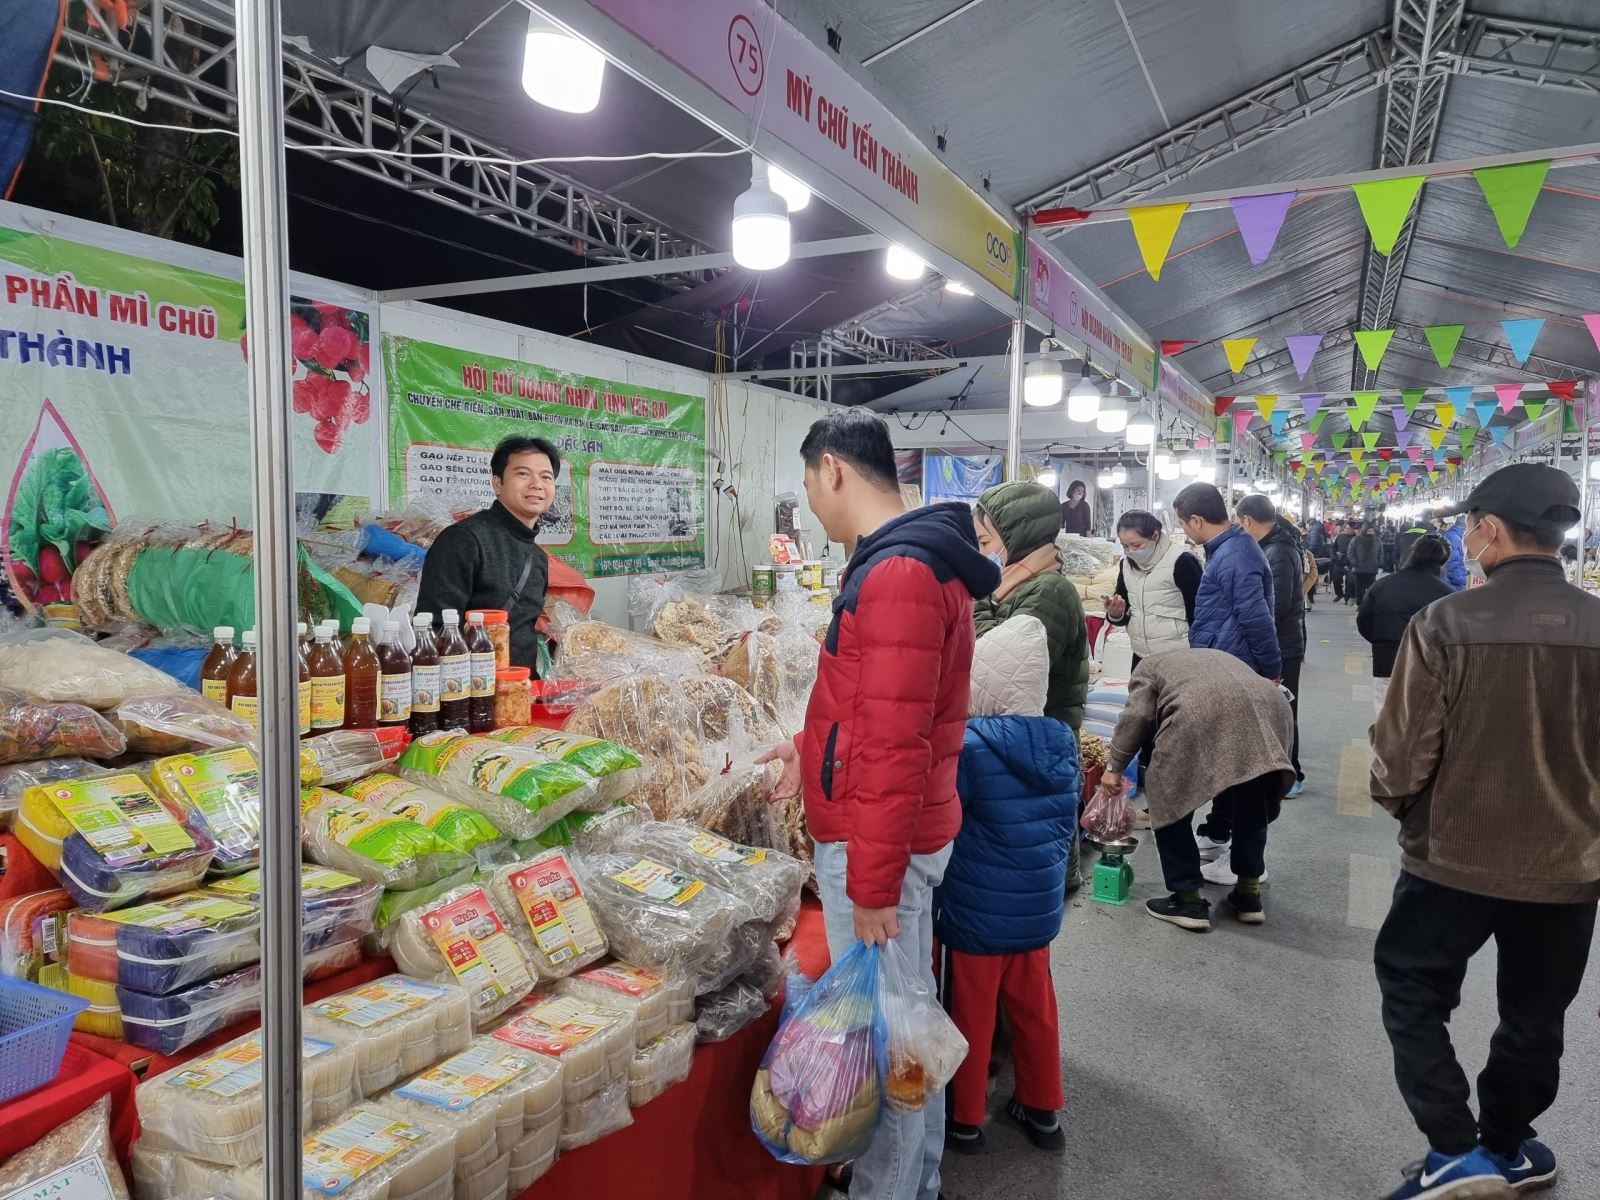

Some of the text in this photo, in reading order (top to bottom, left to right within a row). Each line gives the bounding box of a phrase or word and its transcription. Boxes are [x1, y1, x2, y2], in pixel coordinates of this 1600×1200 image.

[735, 33, 759, 75] 75
[817, 95, 849, 151] CHŨ
[852, 122, 878, 175] YẾN
[881, 151, 920, 205] THÀNH
[5, 272, 216, 339] PHẦN MÌ CHŨ
[0, 329, 132, 375] THÀNH
[461, 362, 488, 395] HỘI
[492, 367, 514, 396] NỮ
[517, 375, 563, 404] DOANH
[564, 384, 599, 410] NHÂN
[629, 393, 649, 418] YÊN
[420, 451, 444, 461] GẠO
[420, 463, 443, 473] GẠO
[420, 475, 443, 485] GẠO
